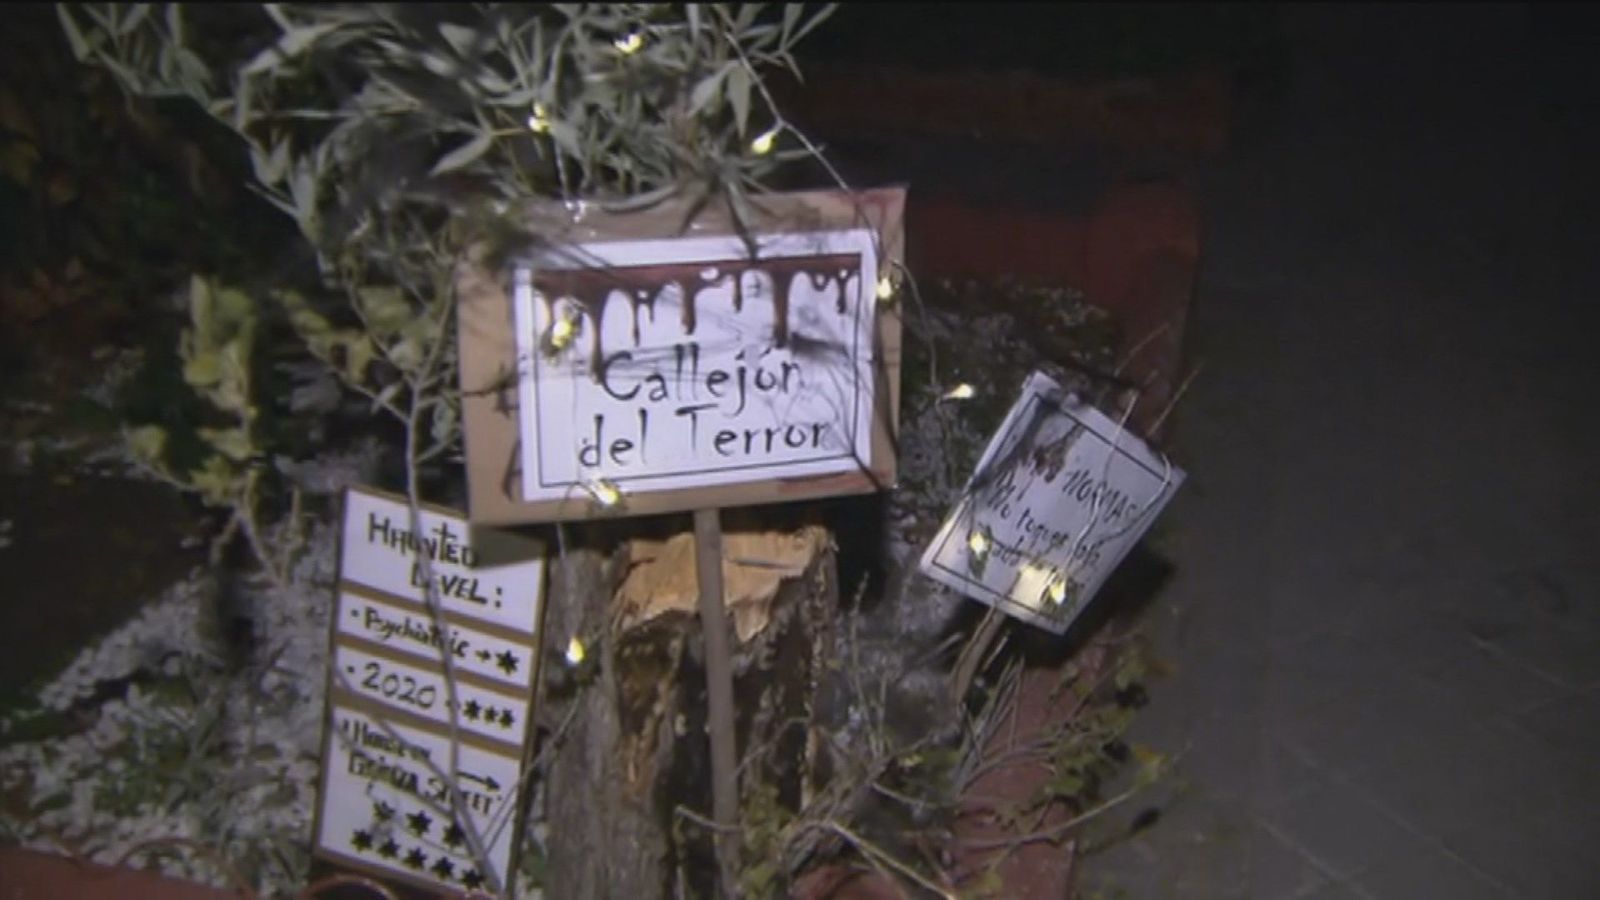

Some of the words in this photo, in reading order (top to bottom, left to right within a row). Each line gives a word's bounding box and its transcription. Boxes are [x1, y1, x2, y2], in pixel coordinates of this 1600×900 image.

[600, 342, 802, 418] Callejón
[578, 408, 648, 468] del
[675, 403, 831, 458] Terror
[410, 562, 503, 608] LVEL:
[364, 606, 470, 658] Psychiatic
[361, 661, 437, 710] 2020
